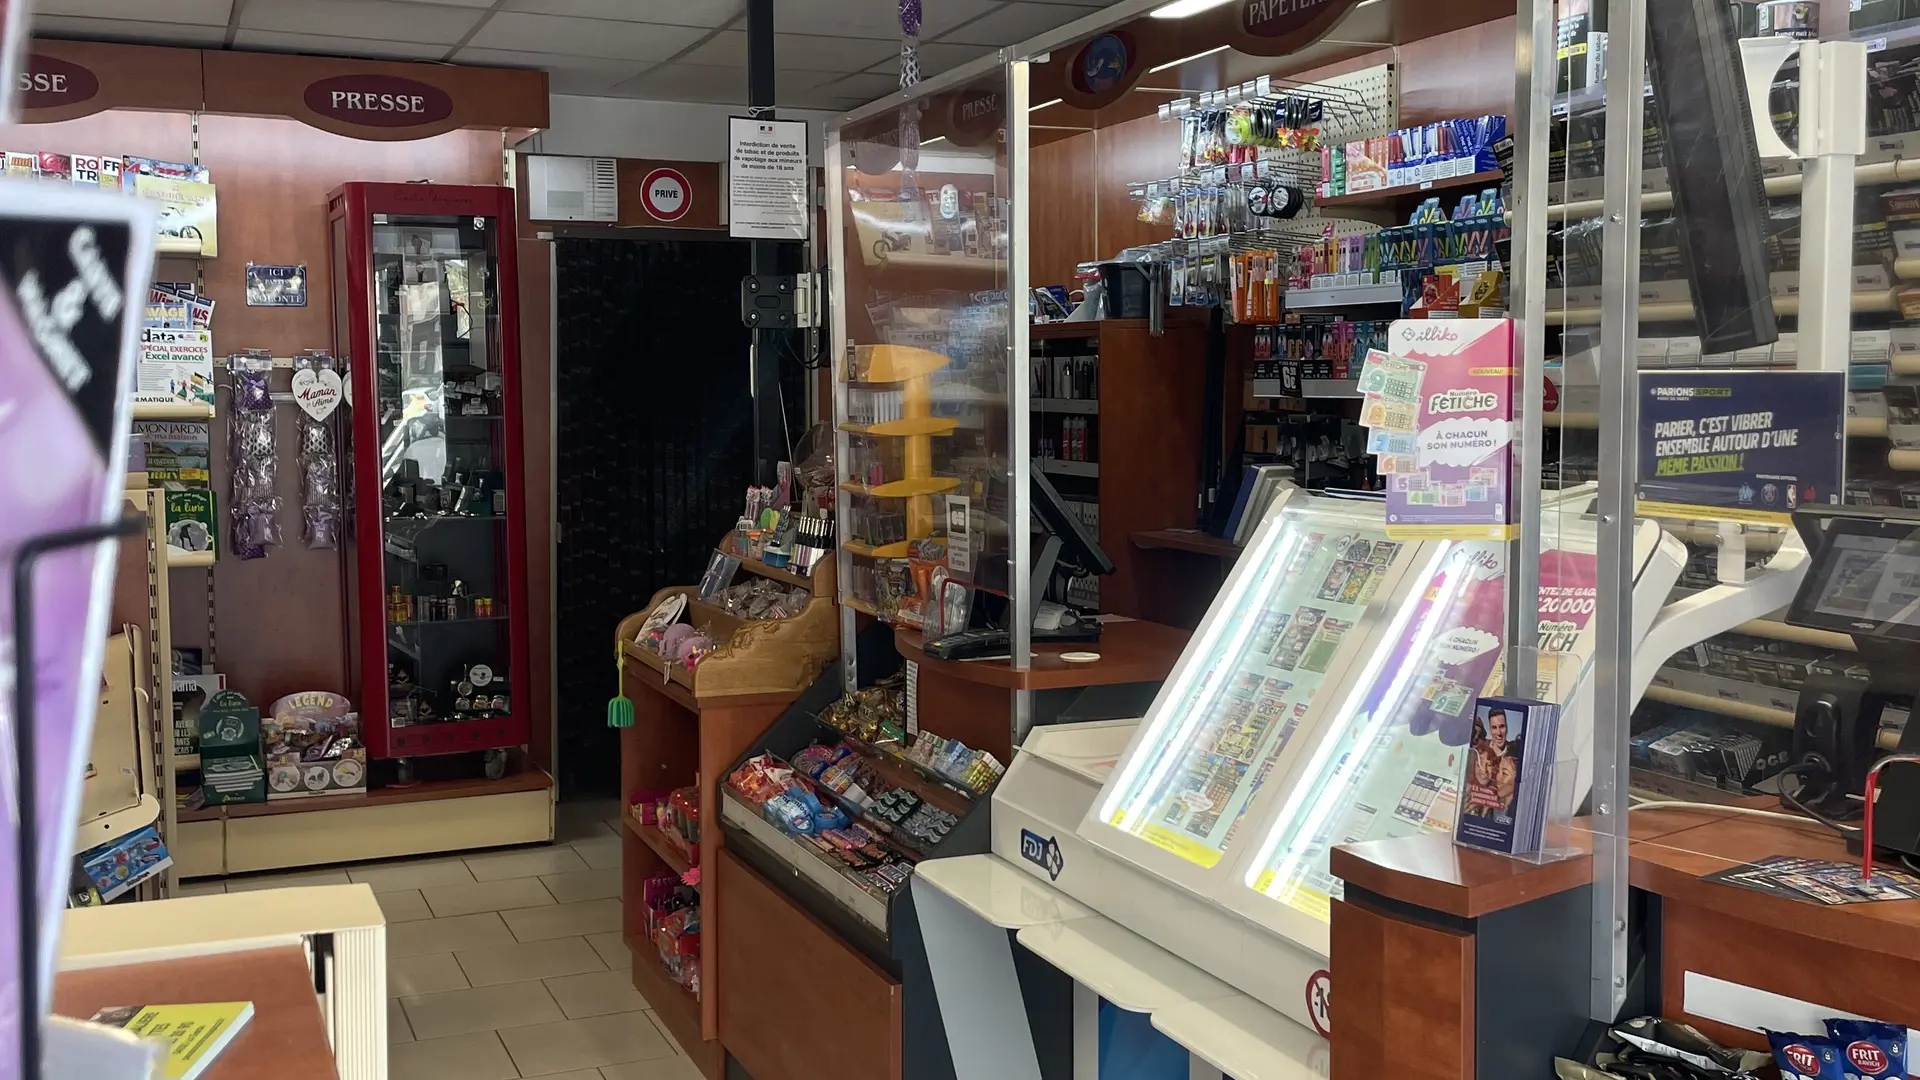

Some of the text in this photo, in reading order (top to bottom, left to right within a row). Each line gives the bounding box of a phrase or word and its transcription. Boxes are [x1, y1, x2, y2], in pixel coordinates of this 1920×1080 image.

[331, 90, 426, 114] PRESSE
[269, 268, 284, 276] ICI
[141, 329, 175, 342] data
[1416, 326, 1458, 341] illiko
[146, 352, 204, 361] Excel avancé
[298, 388, 336, 400] Maman
[1657, 387, 1730, 397] PARIONS SPORT
[138, 423, 207, 435] MON JARDIN
[1654, 411, 1773, 439] PARIER, C'EST VIBRER
[1436, 430, 1488, 440] À CHACUN
[1427, 442, 1448, 450] SON
[1450, 439, 1492, 449] NUMÉRO
[1655, 428, 1799, 457] ENSEMBLE AUTOUR D'UNE
[1690, 454, 1738, 472] PASSION
[1538, 587, 1597, 596] NTEZ DE GAG
[1539, 623, 1573, 632] Numéro
[1453, 636, 1478, 645] CHACUN
[1452, 645, 1477, 653] NUMÉRO
[289, 695, 334, 708] LEGEND
[1023, 835, 1043, 861] FDJ
[1852, 1048, 1880, 1061] FRIT
